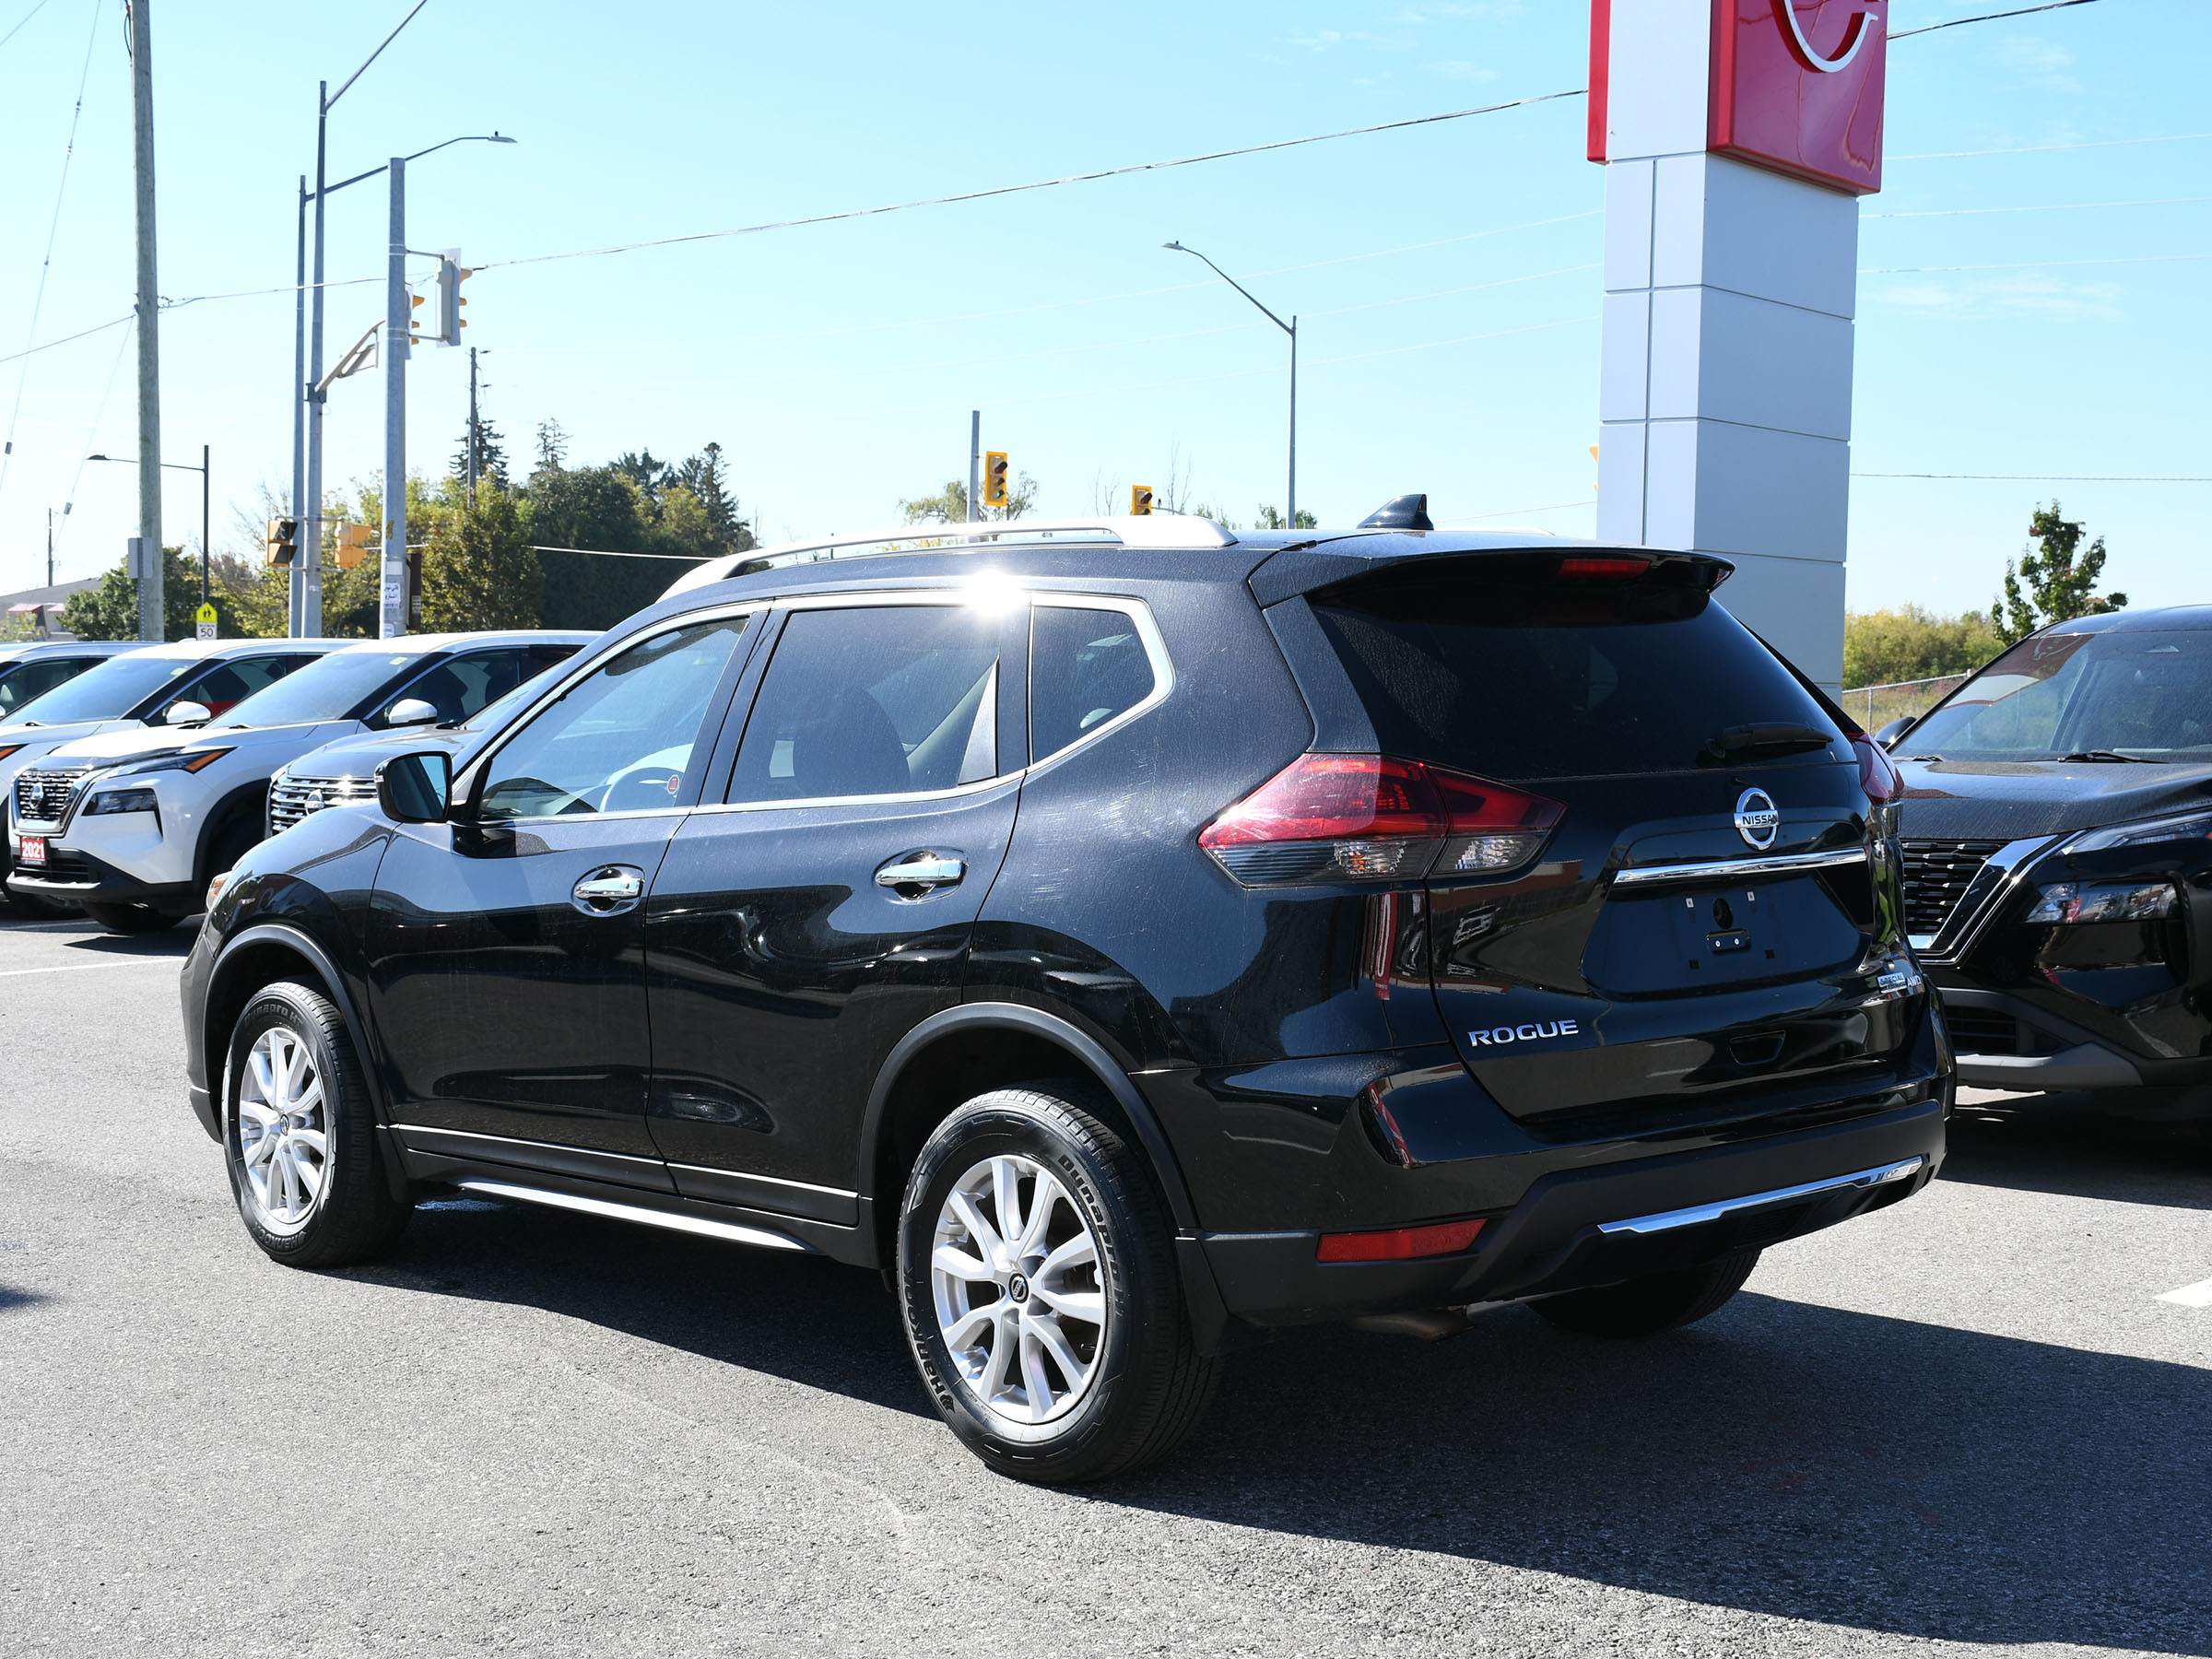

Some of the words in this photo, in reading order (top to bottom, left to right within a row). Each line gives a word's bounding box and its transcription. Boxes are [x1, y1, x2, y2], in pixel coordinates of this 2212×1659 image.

[200, 628, 214, 638] 50
[1742, 815, 1778, 826] NISSAN
[20, 841, 45, 860] 2021
[1467, 1018, 1579, 1047] ROGUE
